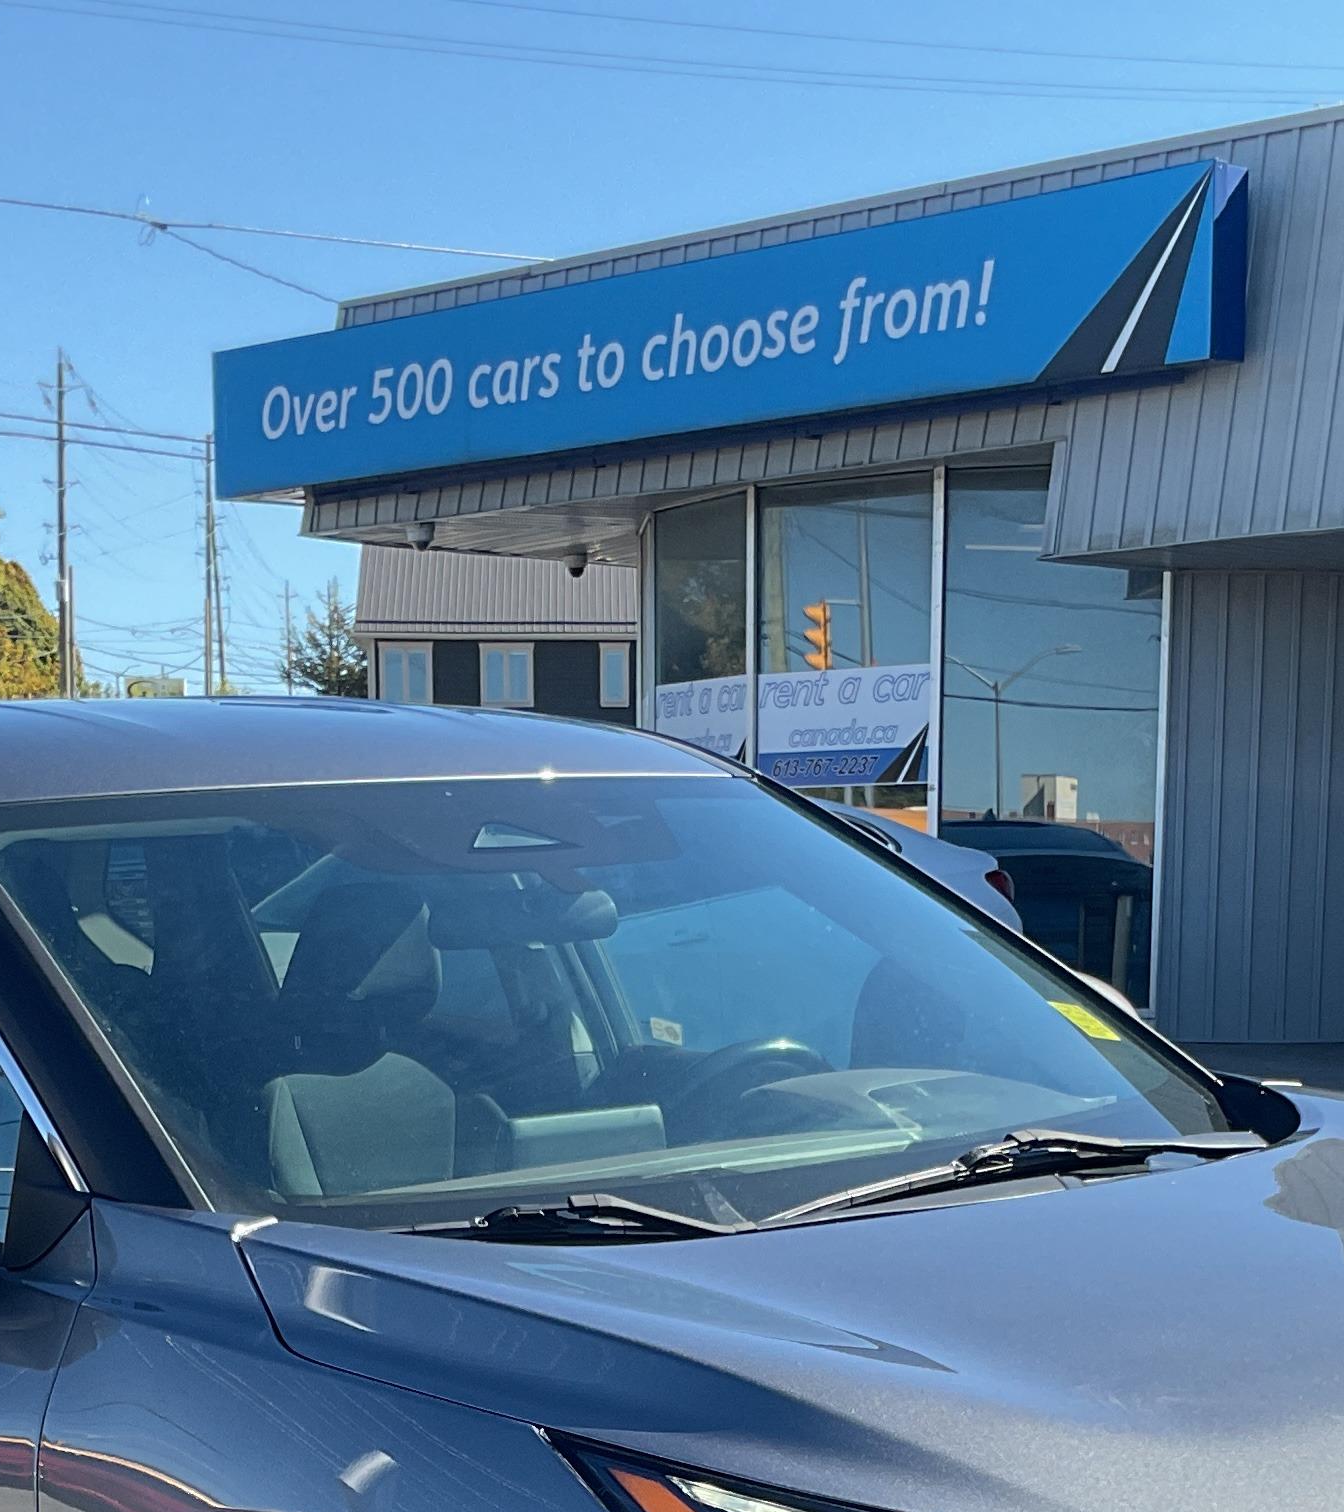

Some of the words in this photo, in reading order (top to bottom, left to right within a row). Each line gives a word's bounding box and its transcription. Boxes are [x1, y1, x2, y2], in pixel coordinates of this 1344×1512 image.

[260, 382, 360, 442] Over
[367, 355, 454, 422] 500
[467, 350, 560, 412] cars
[576, 331, 625, 394] to
[640, 303, 820, 380] choose
[832, 260, 996, 366] from!
[656, 682, 694, 719] rent
[699, 687, 712, 714] a
[759, 671, 828, 709] rent
[837, 677, 861, 705] a
[873, 671, 930, 704] car
[788, 719, 898, 748] canada.ca
[773, 755, 879, 778] 613-767-2237
